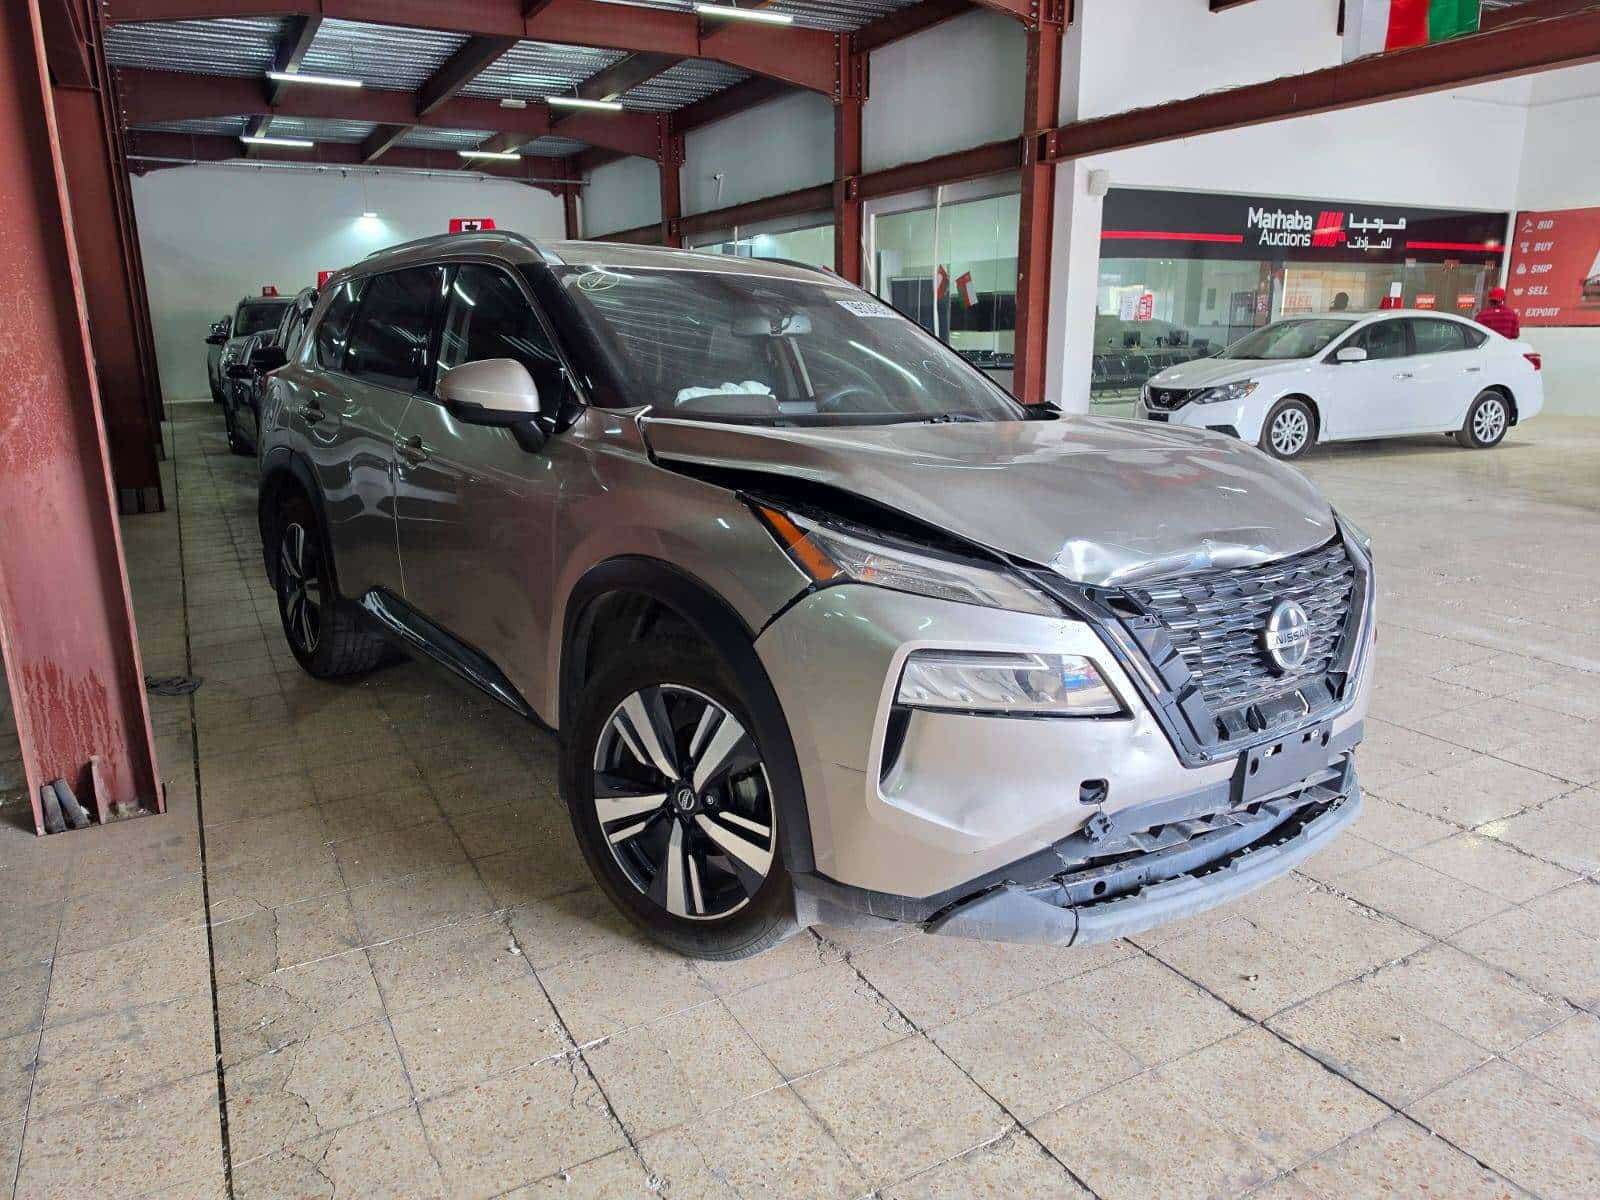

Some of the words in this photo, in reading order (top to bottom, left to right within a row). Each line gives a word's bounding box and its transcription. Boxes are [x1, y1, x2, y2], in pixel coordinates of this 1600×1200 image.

[1247, 207, 1313, 231] Marhaba
[1536, 219, 1554, 230] BID
[1258, 229, 1312, 247] Auctions
[1533, 241, 1554, 252] BUY
[1530, 263, 1553, 274] SHIP
[1527, 285, 1549, 296] SELL
[1524, 307, 1560, 318] EXPORT
[1275, 627, 1311, 646] NISSAN
